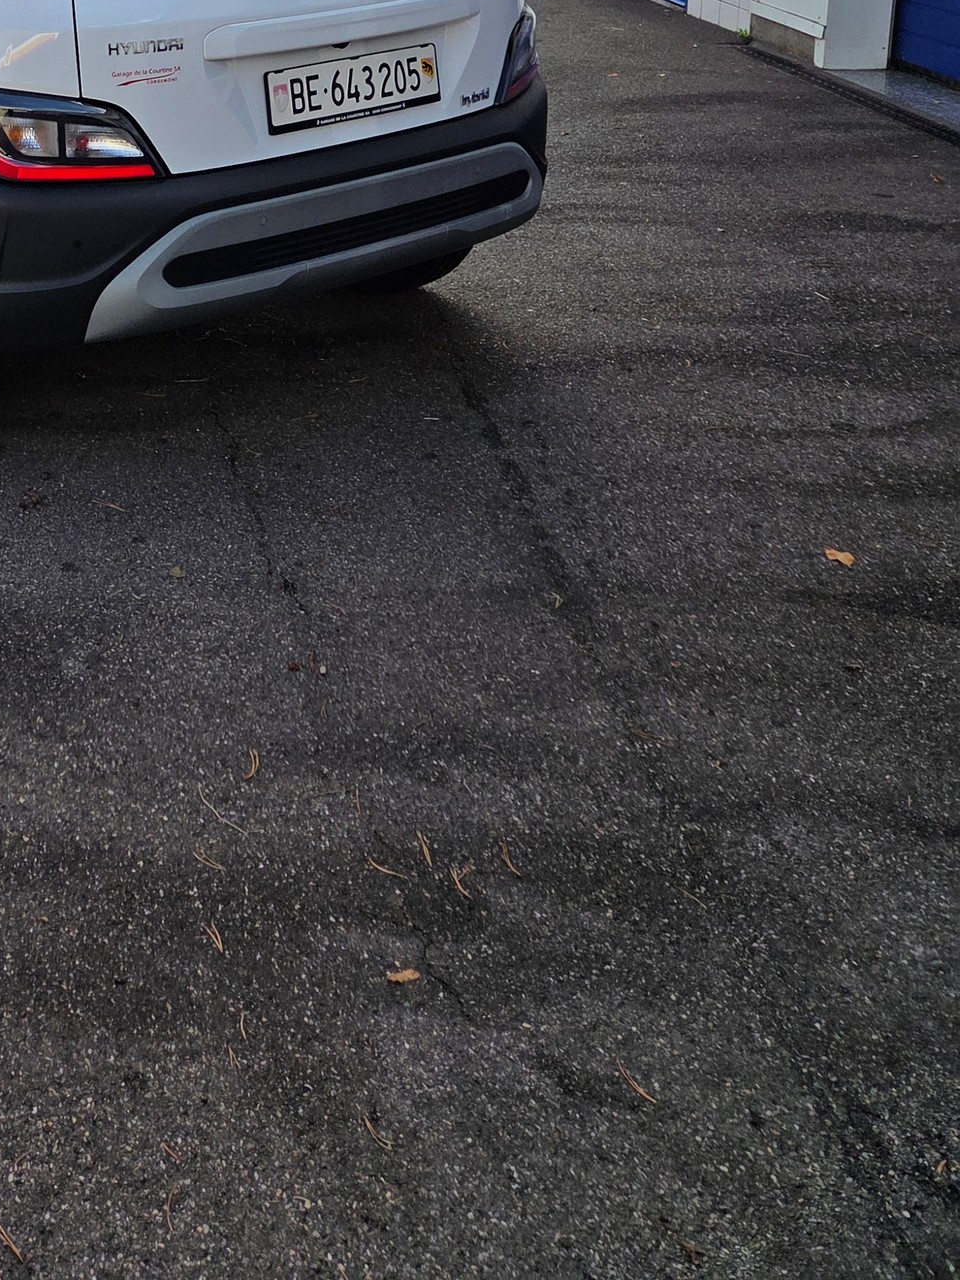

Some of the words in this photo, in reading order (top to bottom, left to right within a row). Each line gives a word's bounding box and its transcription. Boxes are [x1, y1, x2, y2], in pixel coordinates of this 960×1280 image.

[107, 38, 184, 56] HYUNDAI
[111, 70, 133, 78] Garage
[149, 67, 173, 75] Courtine
[461, 87, 490, 108] hybrid
